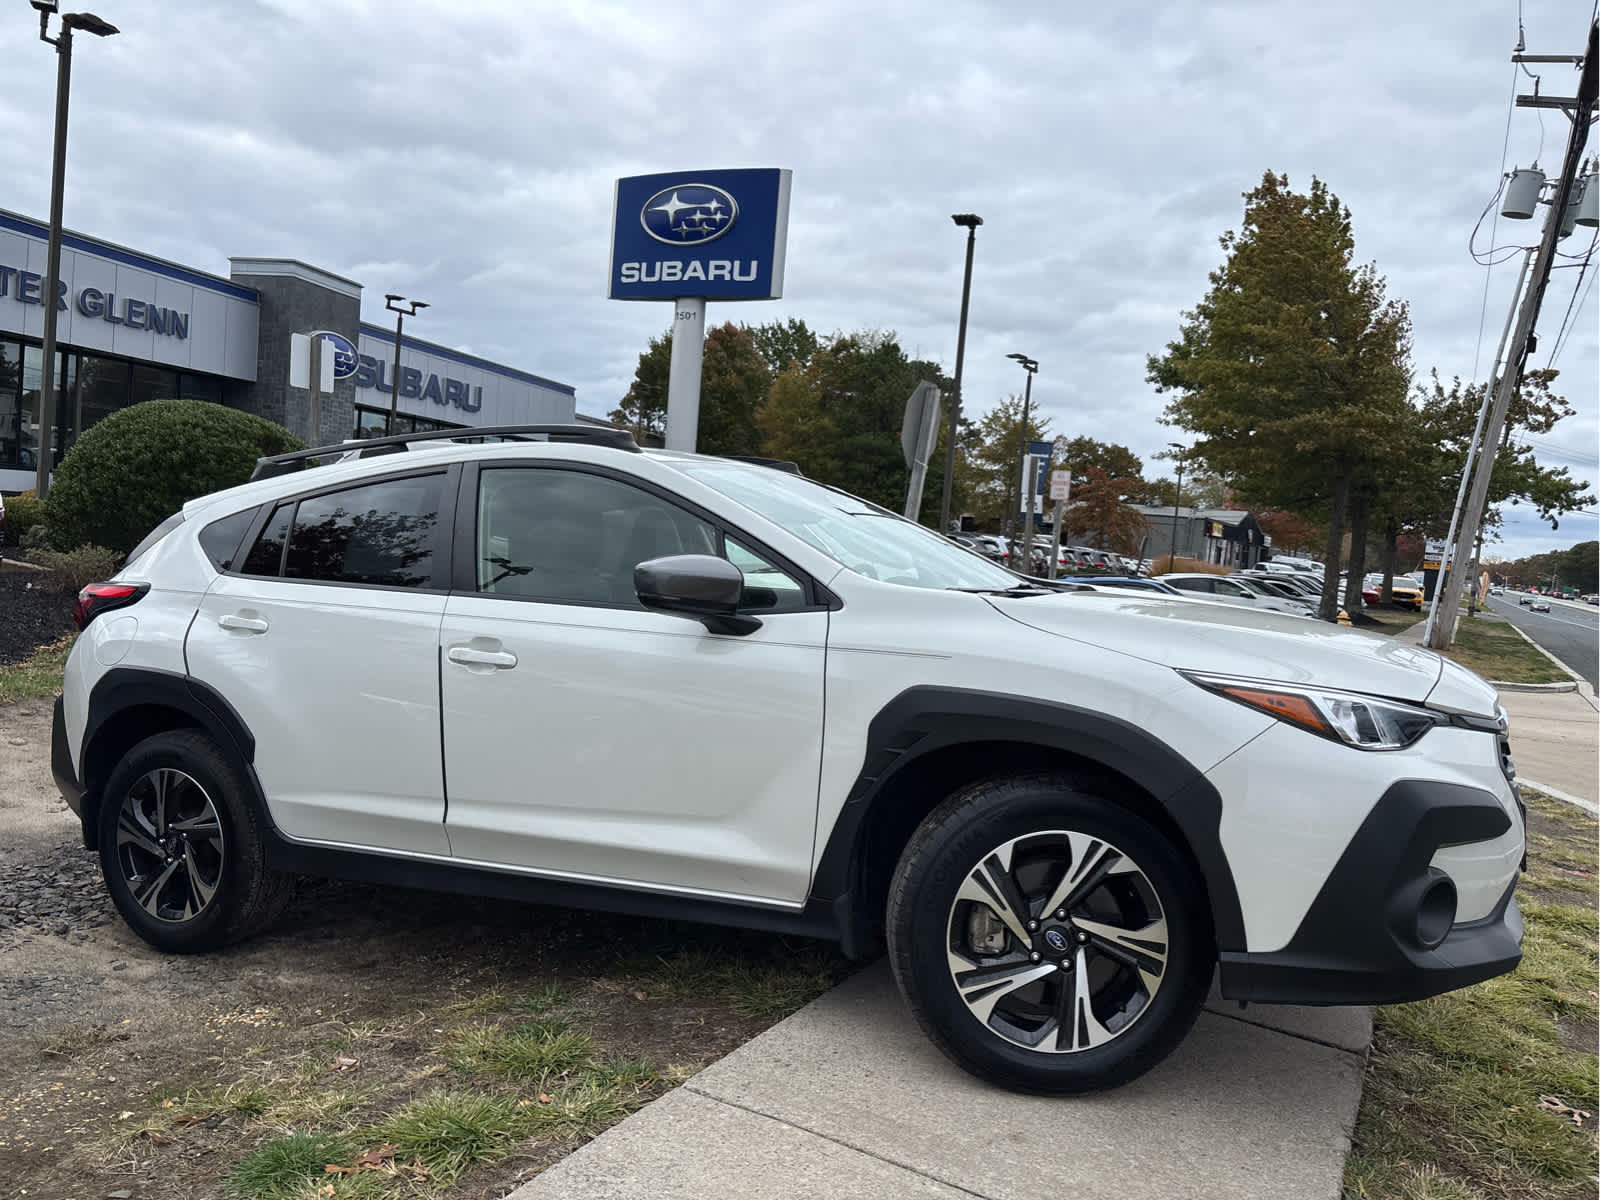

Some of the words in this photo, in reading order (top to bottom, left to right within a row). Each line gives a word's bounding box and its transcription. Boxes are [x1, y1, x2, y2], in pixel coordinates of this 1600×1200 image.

[620, 260, 758, 283] SUBARU
[79, 287, 189, 340] GLENN
[675, 311, 697, 321] 1501
[356, 353, 483, 413] SUBARU
